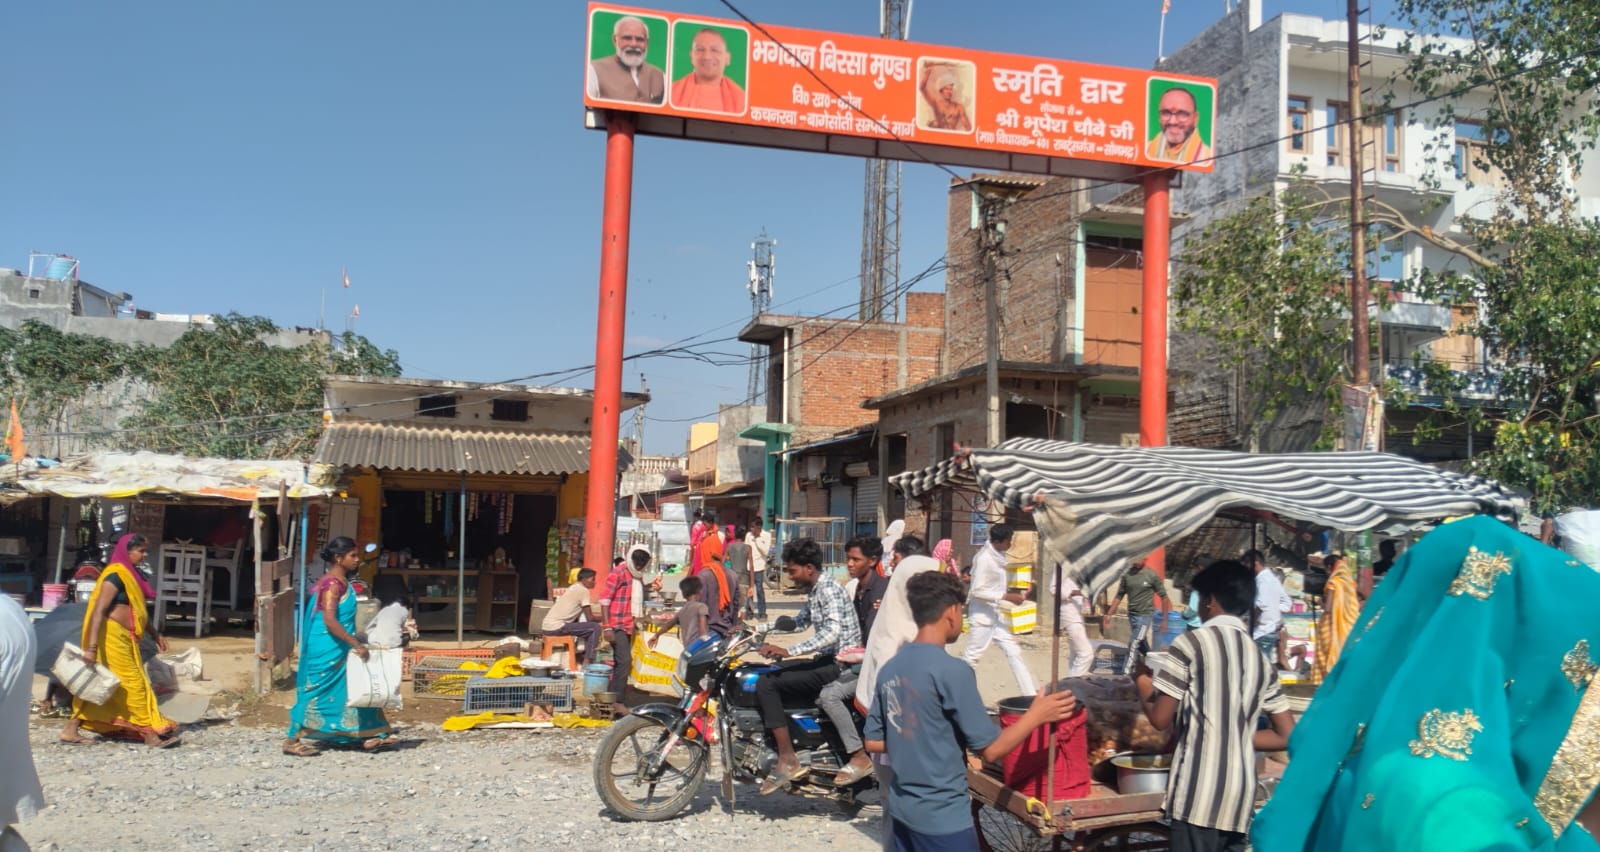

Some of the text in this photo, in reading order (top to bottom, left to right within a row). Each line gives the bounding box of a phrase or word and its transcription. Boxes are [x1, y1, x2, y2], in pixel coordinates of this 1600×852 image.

[753, 39, 912, 89] भगवान बिरसा मुण्डा
[992, 63, 1127, 105] स्मृति द्वार
[891, 117, 917, 137] मार्ग
[996, 107, 1019, 128] श्री
[1023, 113, 1067, 137] भूपेश
[1109, 120, 1134, 141] जी
